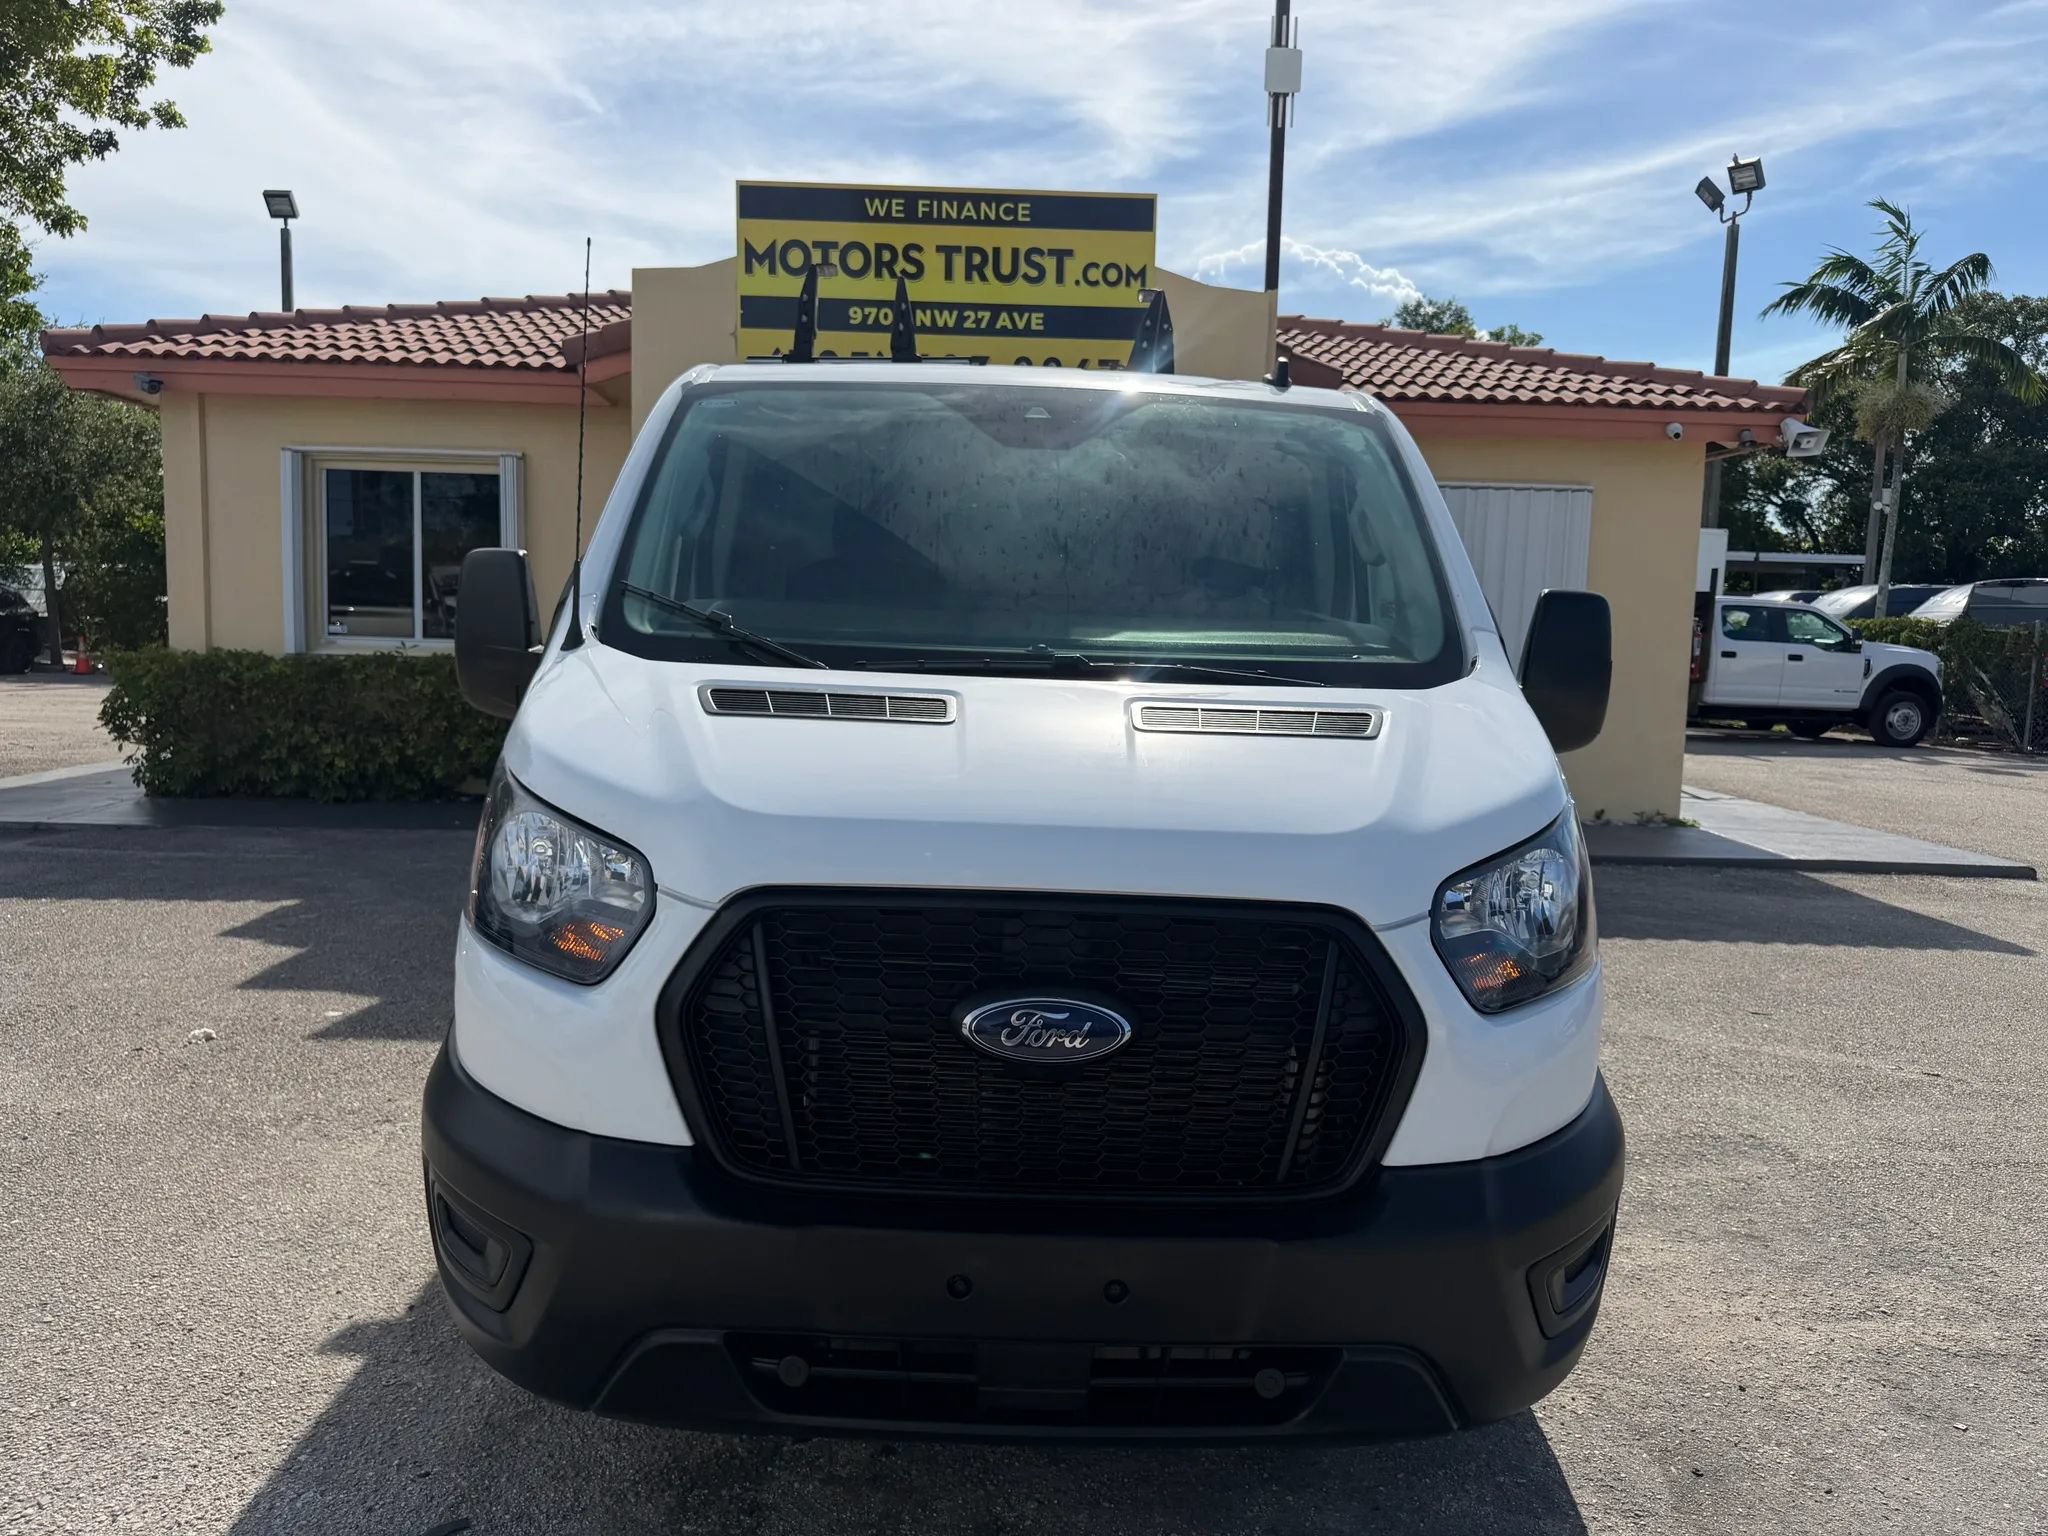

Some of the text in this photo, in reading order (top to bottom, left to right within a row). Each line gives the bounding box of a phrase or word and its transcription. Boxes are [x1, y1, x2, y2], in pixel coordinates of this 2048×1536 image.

[864, 198, 1031, 222] WE FINANCE
[744, 237, 925, 281] MOTORS
[848, 306, 1045, 331] 970 NW 27 AVE
[1001, 1008, 1093, 1049] Ford
